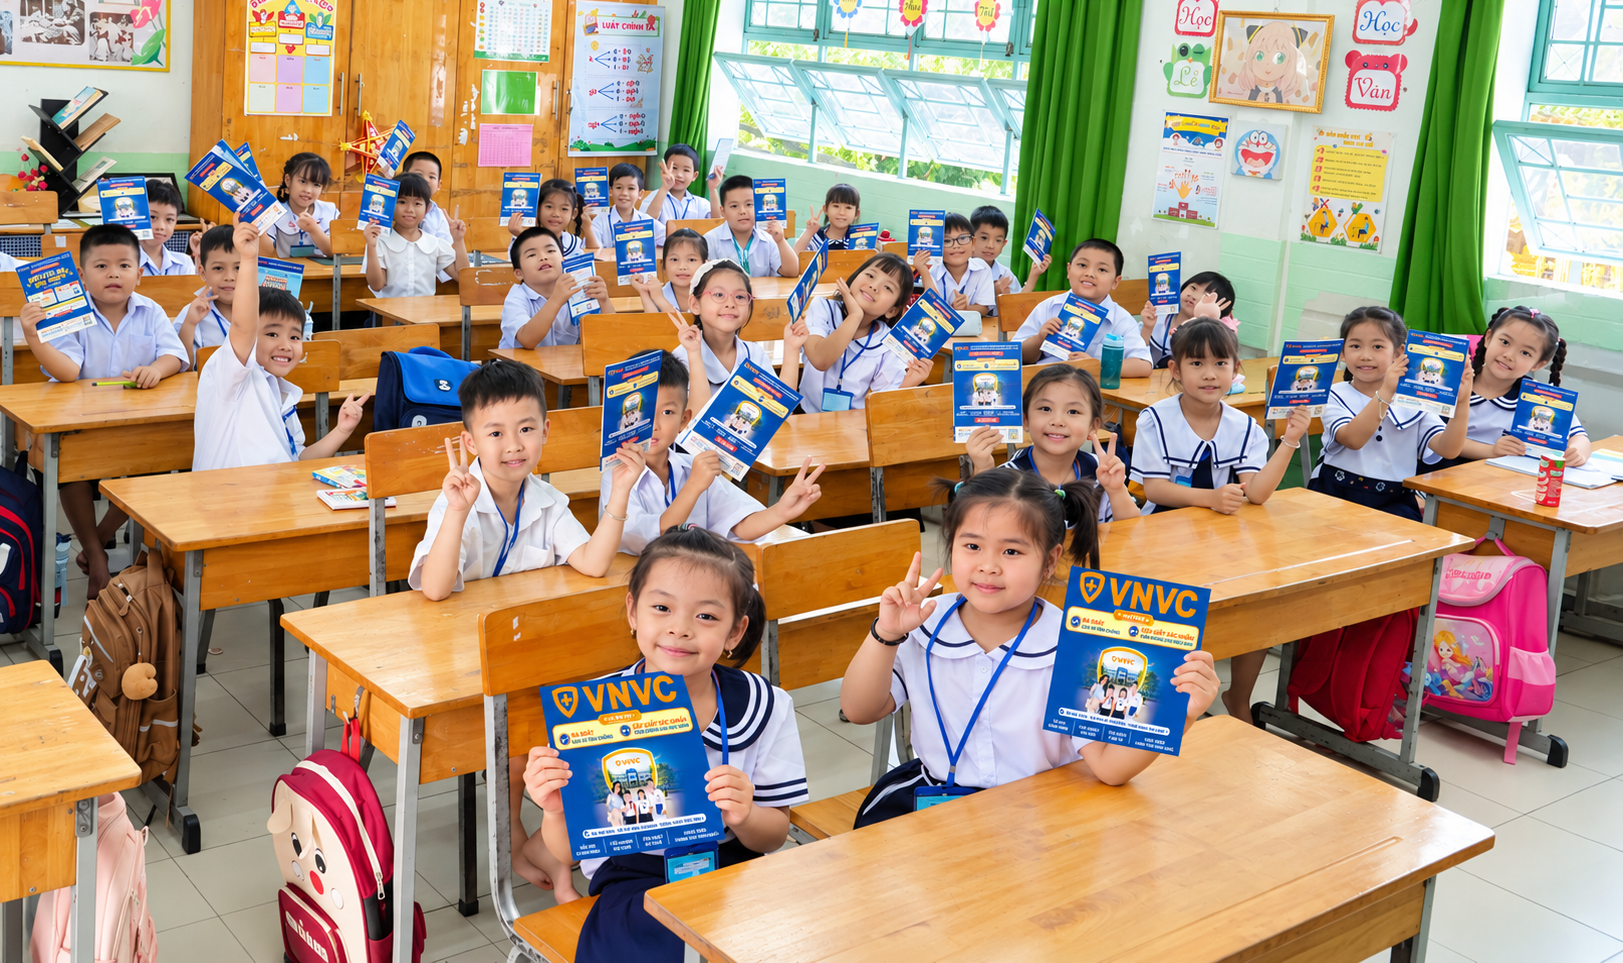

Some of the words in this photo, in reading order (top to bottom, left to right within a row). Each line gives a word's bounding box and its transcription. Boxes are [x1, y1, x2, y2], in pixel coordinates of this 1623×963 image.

[1179, 6, 1212, 29] Học
[1360, 10, 1402, 36] Học
[1109, 577, 1198, 618] VNVC
[581, 675, 677, 712] VNVC
